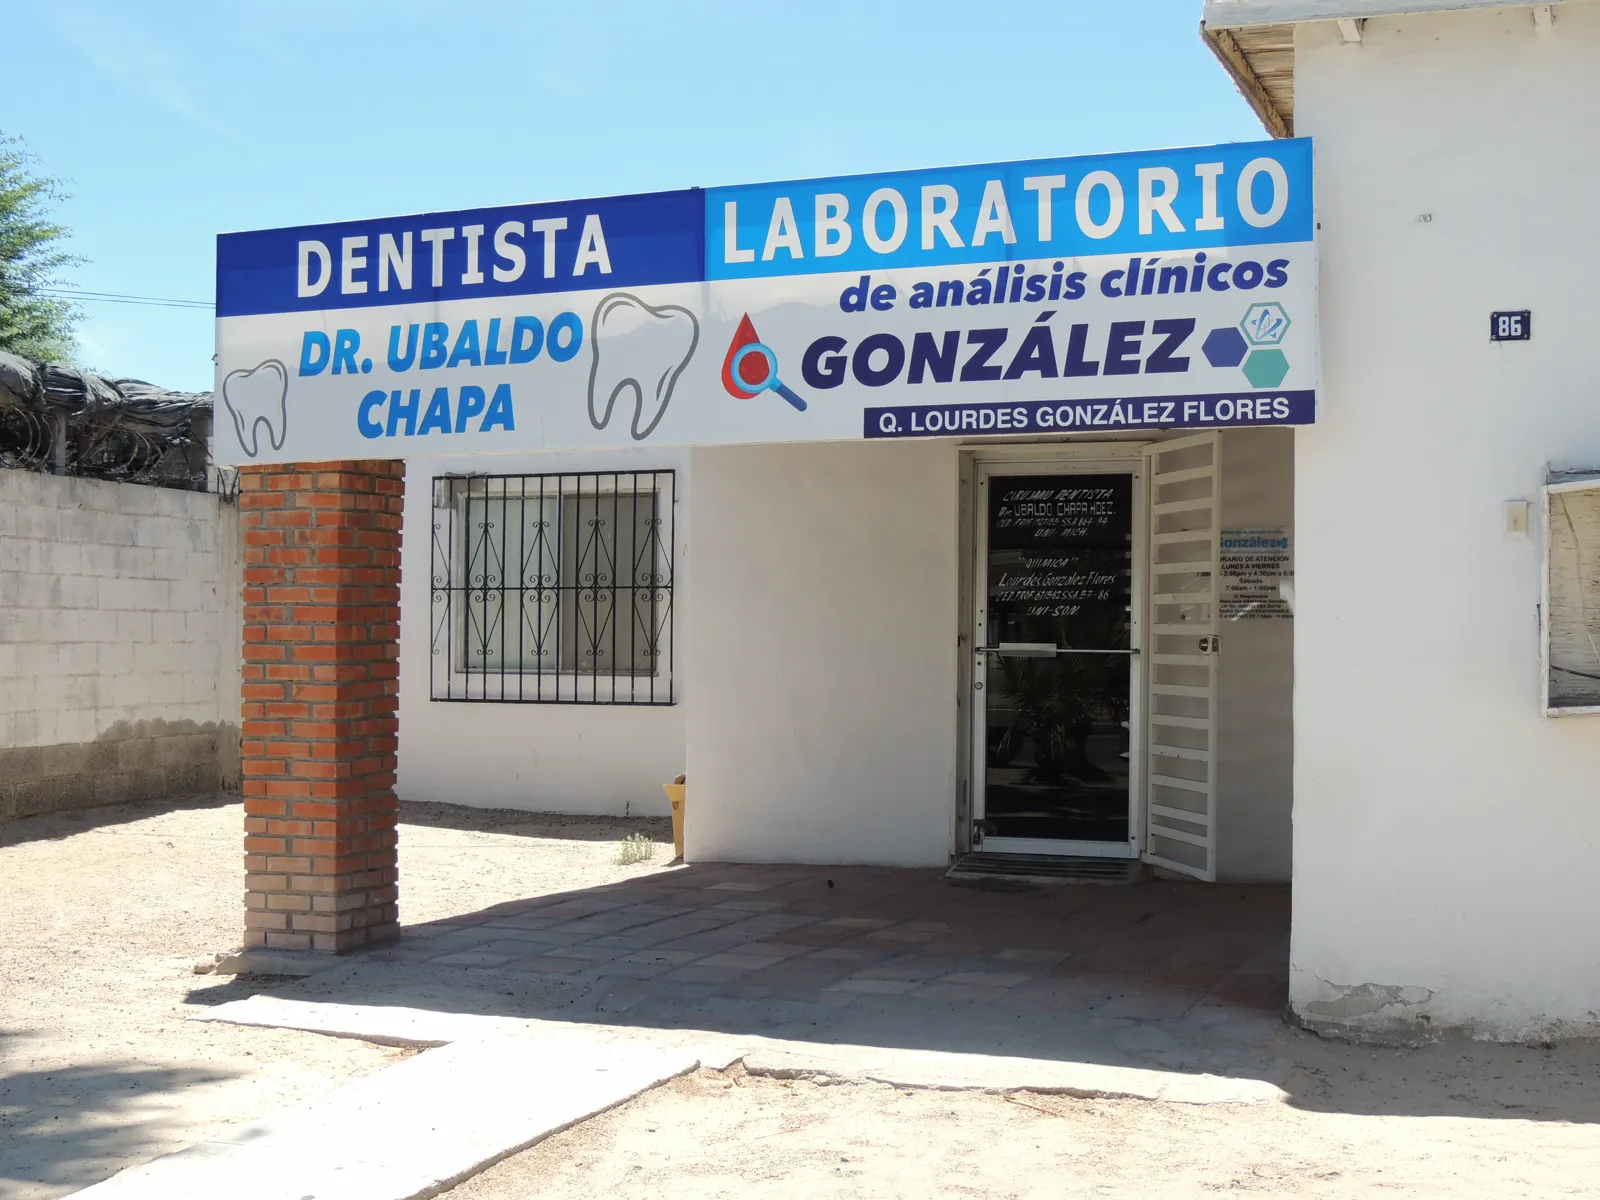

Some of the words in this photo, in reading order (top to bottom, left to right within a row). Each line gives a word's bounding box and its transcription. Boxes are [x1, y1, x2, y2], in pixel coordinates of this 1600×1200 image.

[724, 156, 1289, 264] LABORATORIO
[297, 214, 612, 298] DENTISTA
[839, 275, 896, 313] de
[909, 259, 1088, 309] análisis
[1100, 252, 1290, 299] clínicos
[298, 328, 372, 377] DR.
[386, 311, 584, 373] UBALDO
[1498, 316, 1522, 336] 86
[801, 311, 1197, 390] GONZÁLEZ
[357, 383, 515, 439] CHAPA
[878, 412, 903, 434] Q.
[911, 408, 1029, 432] LOURDES
[1035, 399, 1176, 428] GONZÁLEZ
[1182, 397, 1290, 422] FLORES
[1003, 490, 1055, 502] CIRUJANO
[1054, 489, 1114, 501] DENTISTA
[1014, 502, 1052, 516] UBALDO
[1057, 502, 1088, 516] CHAPA
[1220, 536, 1278, 548] onzález
[1085, 571, 1117, 585] Flores
